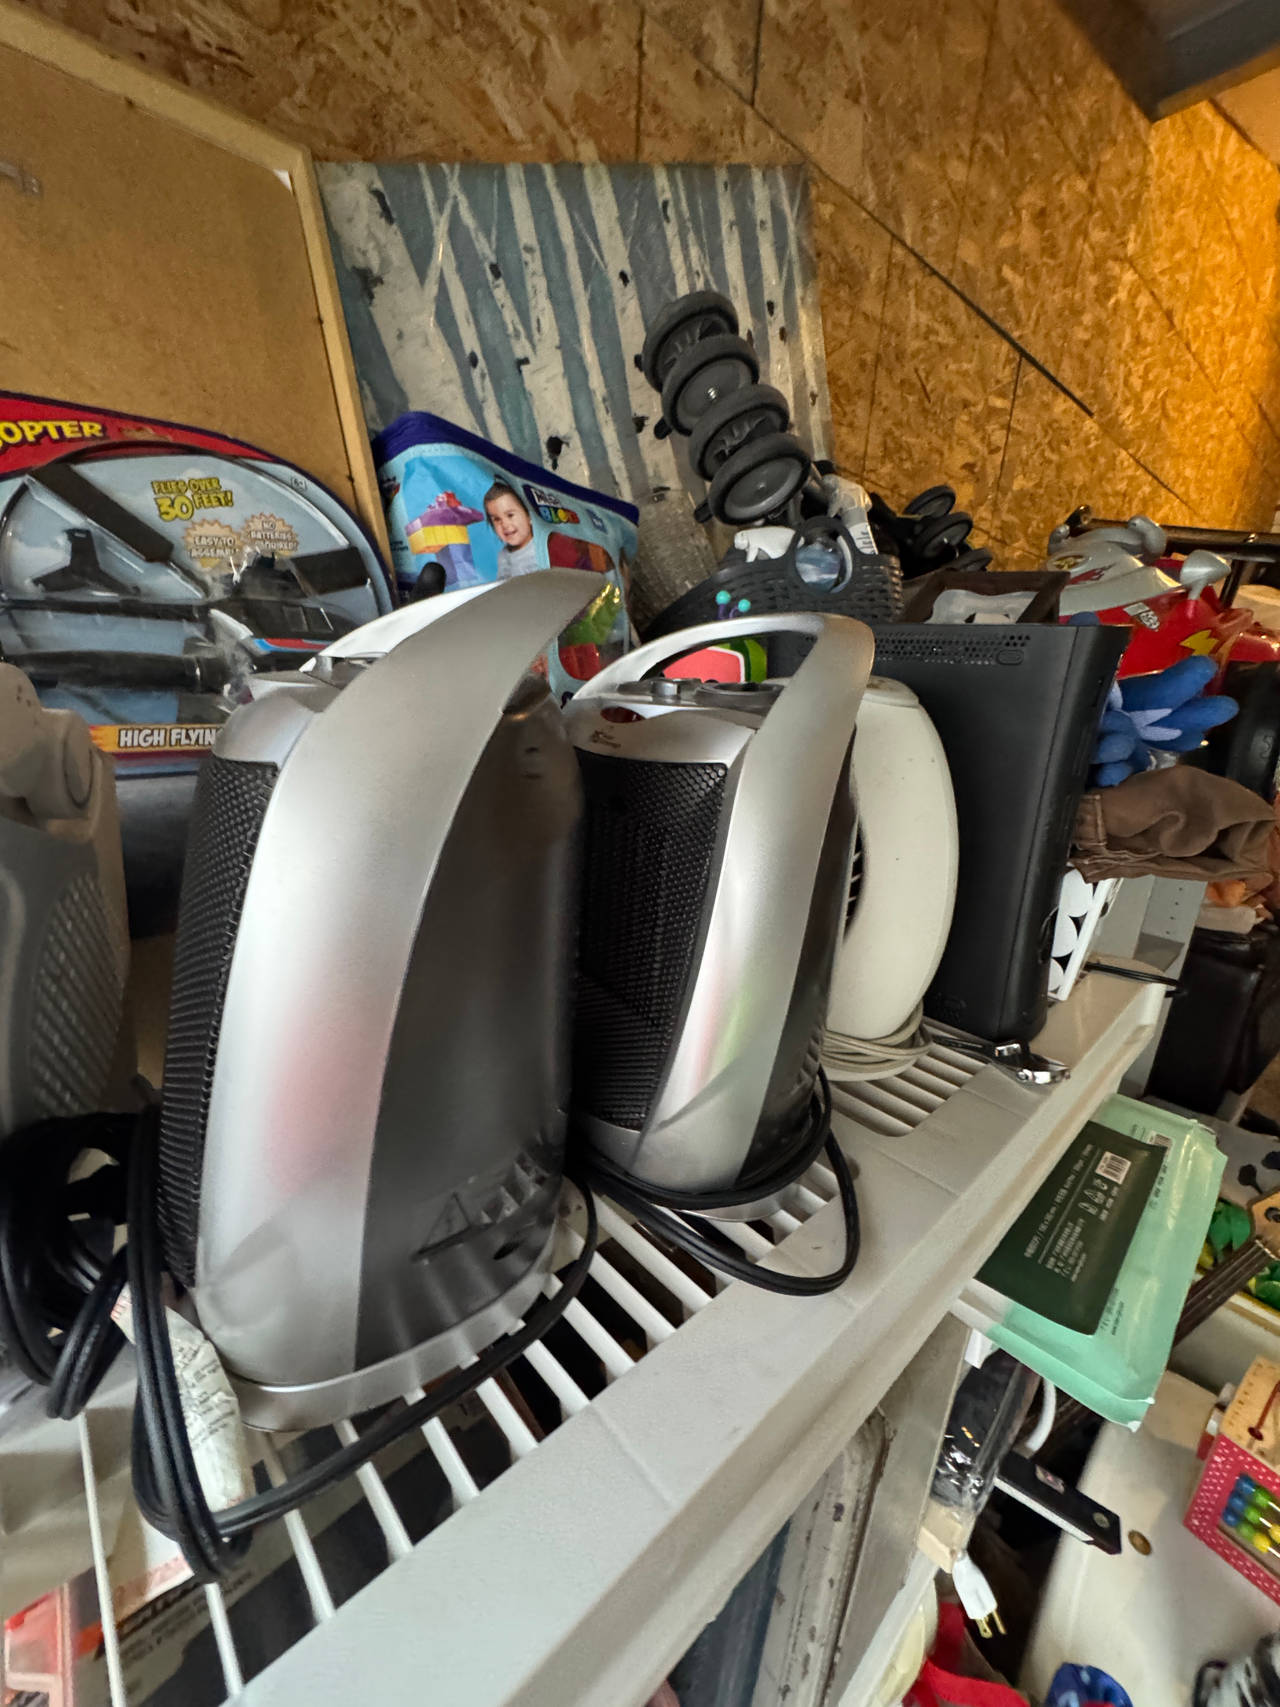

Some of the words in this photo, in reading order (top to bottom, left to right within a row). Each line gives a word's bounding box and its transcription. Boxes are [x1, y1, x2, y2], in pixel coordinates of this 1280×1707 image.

[0, 420, 104, 447] OPTER
[152, 480, 187, 495] FLIES
[188, 478, 221, 491] OVER
[155, 495, 194, 521] 30
[194, 490, 233, 509] FEET!
[193, 536, 219, 546] EASY
[119, 729, 166, 748] HIGH
[170, 728, 219, 746] FLYIN
